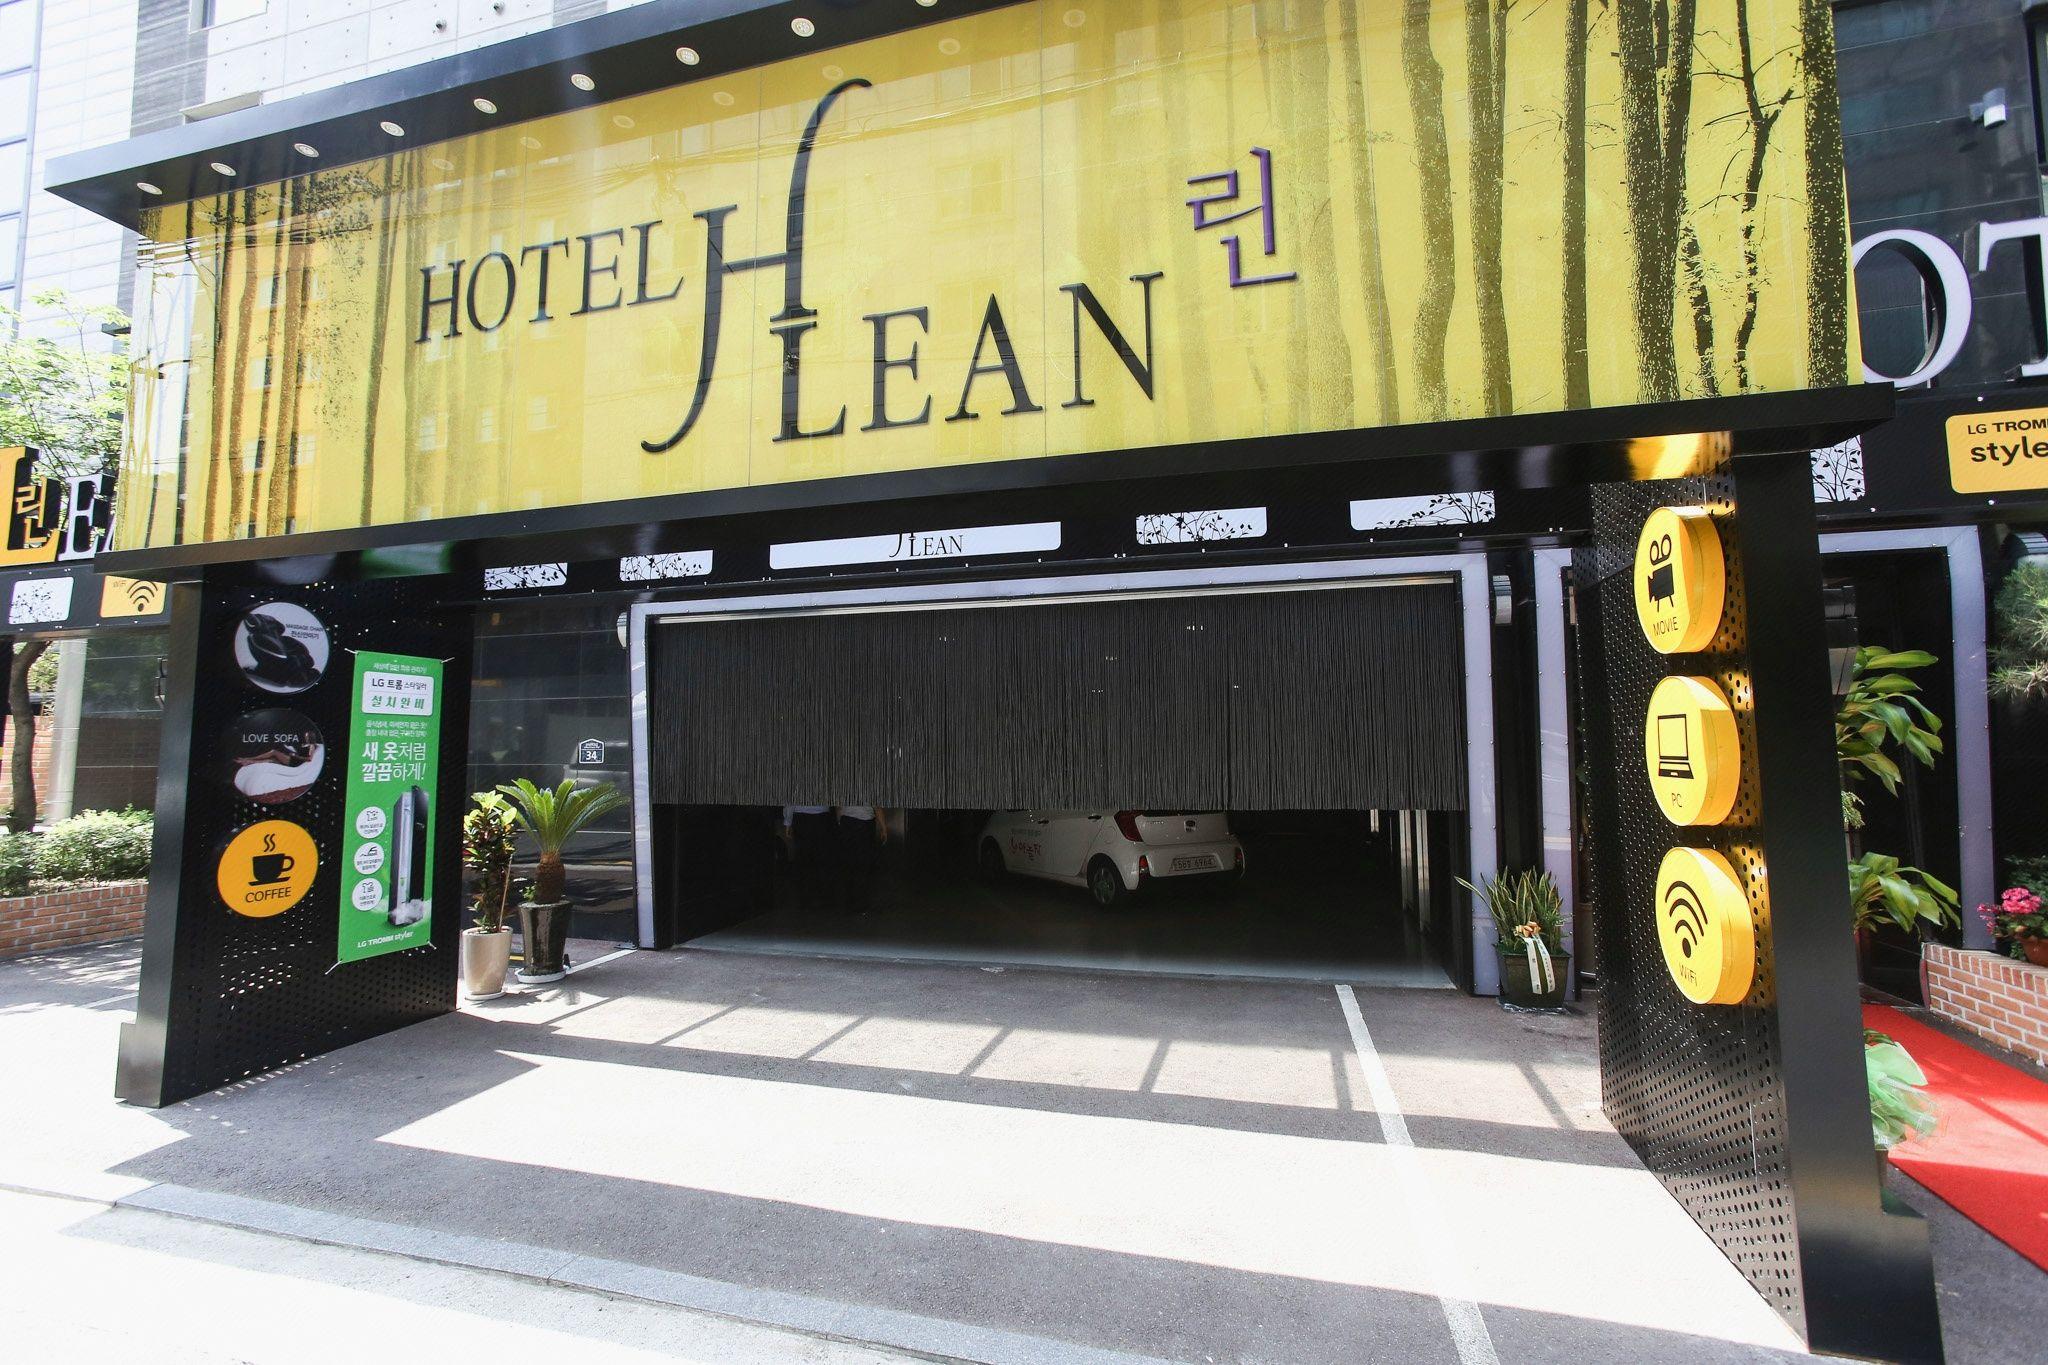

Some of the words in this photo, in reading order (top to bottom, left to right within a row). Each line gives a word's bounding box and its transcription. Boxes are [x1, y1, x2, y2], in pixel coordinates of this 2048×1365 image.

[1186, 146, 1298, 289] 린
[414, 220, 685, 344] HOTEL
[1967, 423, 1987, 435] LG
[1991, 418, 2048, 432] TROM
[16, 475, 47, 544] 린
[1653, 616, 1679, 636] MOVIE
[372, 678, 385, 687] LG
[387, 679, 403, 691] 트롬
[404, 681, 427, 691] 스타일러
[242, 733, 269, 743] LOVE
[274, 733, 299, 743] SOFA
[362, 741, 379, 761] 새
[383, 741, 426, 761] 옷처럼
[585, 750, 598, 761] 34
[362, 762, 427, 783] 깔끔하게!
[1671, 792, 1683, 808] PC
[245, 886, 292, 904] COFFEE
[357, 940, 367, 948] LG
